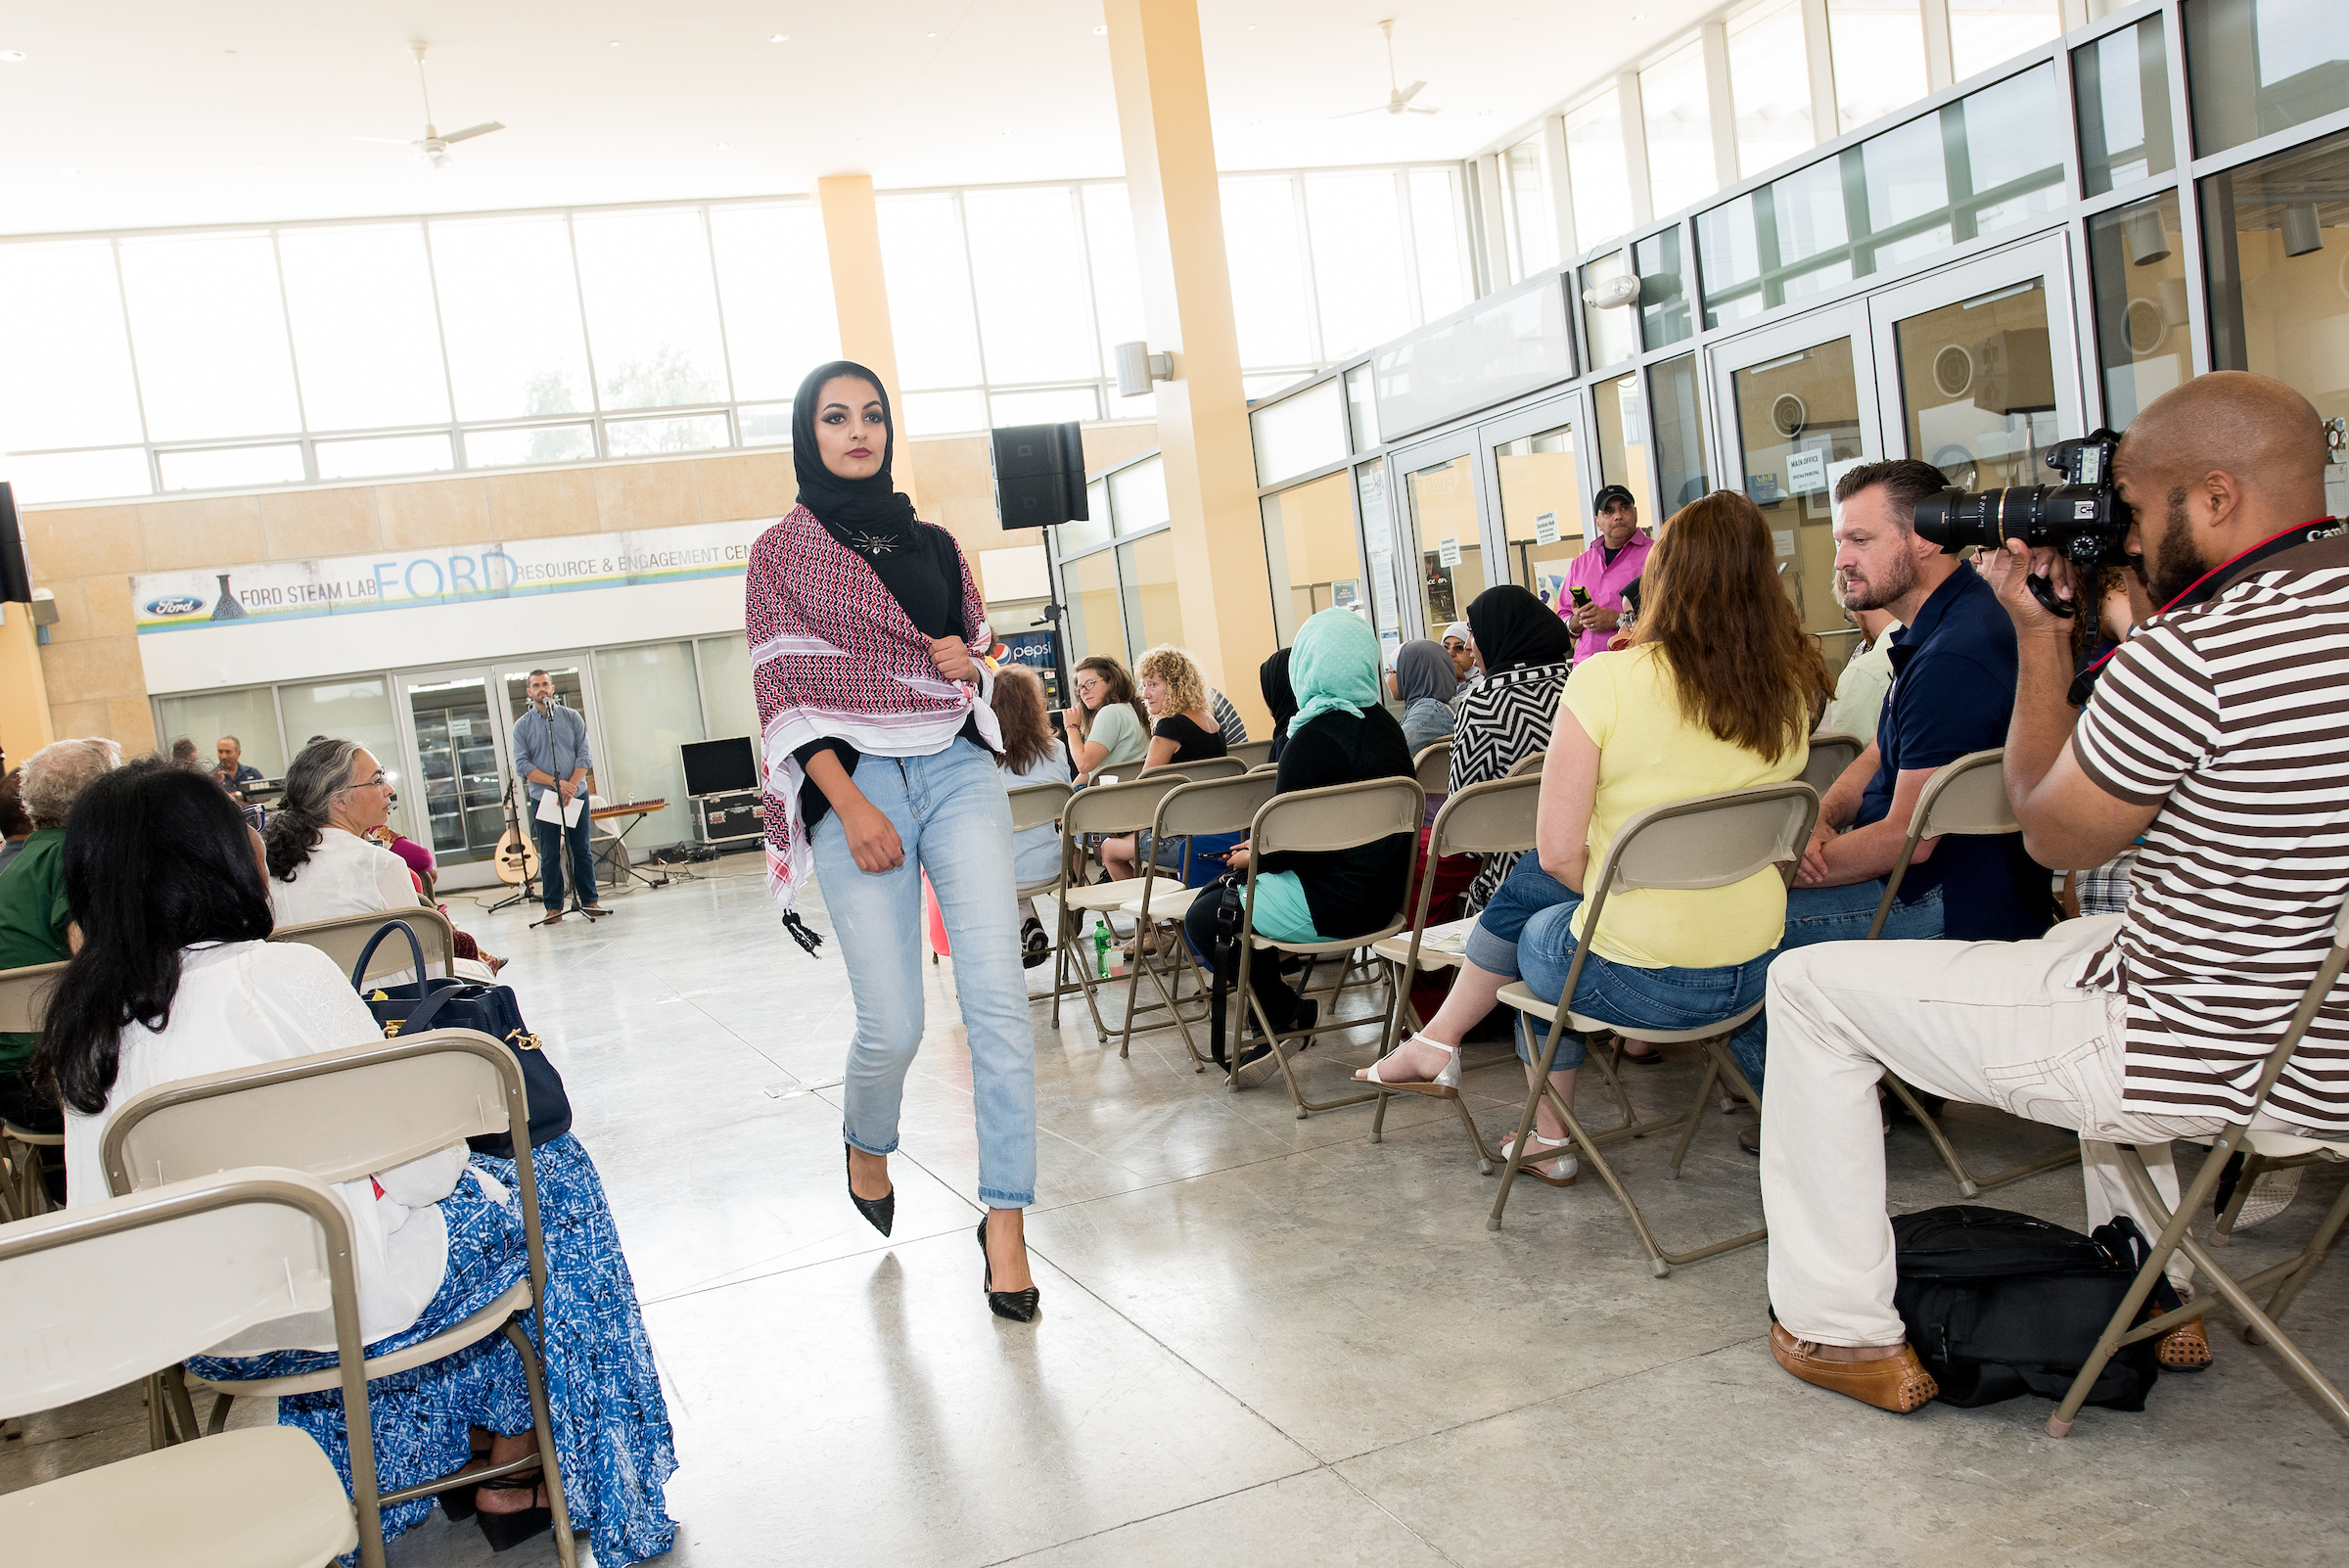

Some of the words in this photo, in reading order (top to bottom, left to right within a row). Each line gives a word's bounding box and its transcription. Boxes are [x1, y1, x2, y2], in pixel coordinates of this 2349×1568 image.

[1791, 459, 1803, 468] MAIN
[1803, 454, 1819, 465] OFFICE
[373, 551, 518, 605] FORD
[516, 559, 598, 581] RESOURCE
[602, 558, 614, 573] &
[618, 547, 720, 571] ENGAGEMENT
[240, 587, 283, 607] FORD
[287, 581, 343, 604] STEAM
[346, 578, 378, 598] LAB
[156, 597, 194, 615] Ford
[1013, 641, 1052, 661] pepsi
[249, 781, 270, 791] KORG
